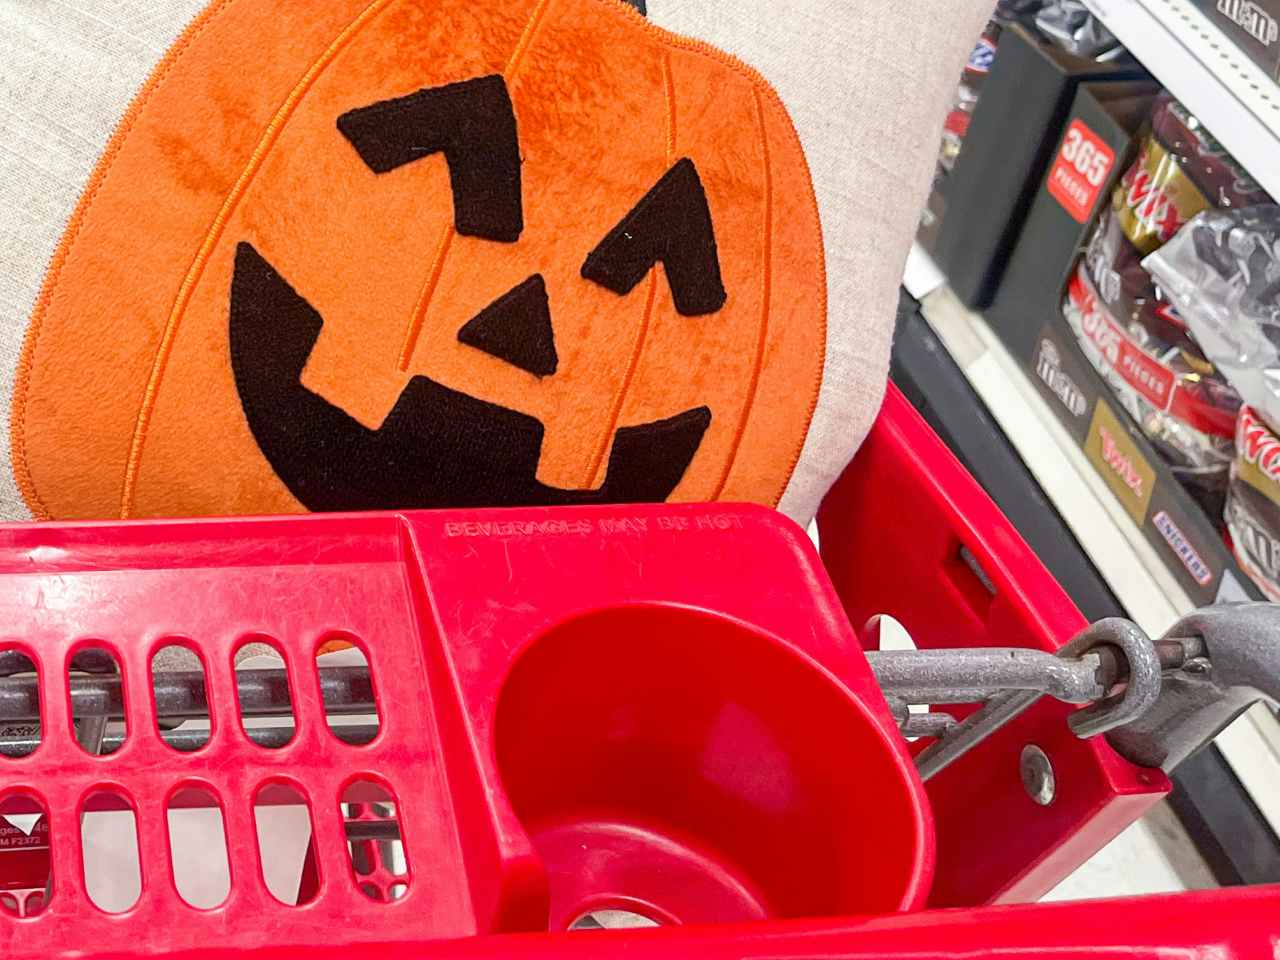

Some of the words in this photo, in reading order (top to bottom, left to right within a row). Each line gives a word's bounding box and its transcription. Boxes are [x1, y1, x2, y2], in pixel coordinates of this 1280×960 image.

[1062, 127, 1109, 187] 365
[444, 520, 592, 538] BEVERAGES
[599, 517, 649, 533] MAY
[657, 516, 688, 531] BE
[695, 513, 745, 530] HOT
